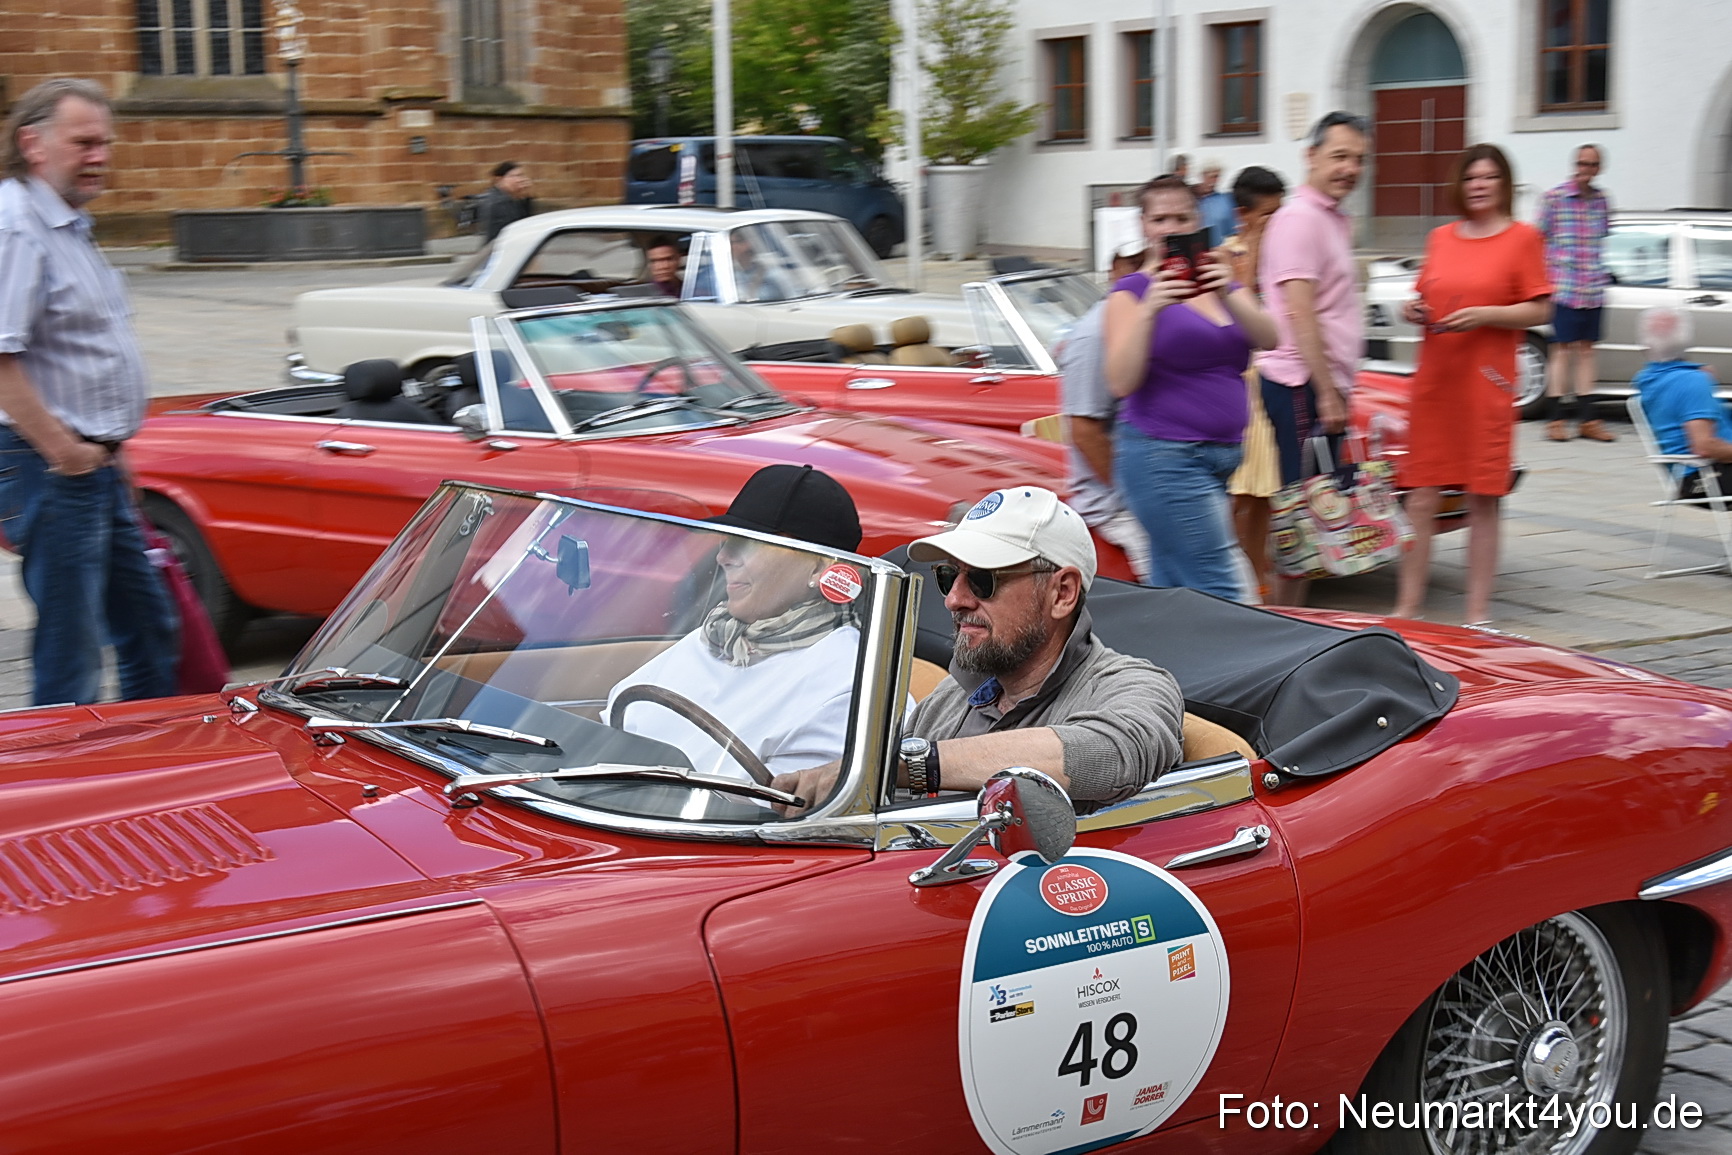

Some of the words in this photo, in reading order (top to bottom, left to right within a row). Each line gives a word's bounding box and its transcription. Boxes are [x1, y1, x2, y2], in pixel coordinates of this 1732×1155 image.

[829, 574, 851, 587] JANDA
[1047, 876, 1098, 895] CLASSIC
[1055, 888, 1098, 905] SPRINT
[1025, 919, 1131, 954] SONNLEITNER
[1137, 921, 1150, 937] S
[1111, 935, 1134, 949] AUTO
[1171, 947, 1190, 962] PRINT
[1177, 957, 1187, 967] and
[1172, 962, 1192, 977] PIXEL
[1076, 977, 1121, 999] HISCOX
[1078, 999, 1095, 1009] WISSEN
[1058, 1012, 1138, 1087] 48
[1135, 1083, 1163, 1098] JANDA
[1133, 1091, 1165, 1106] DORRER
[1012, 1116, 1065, 1136] Lämmermann
